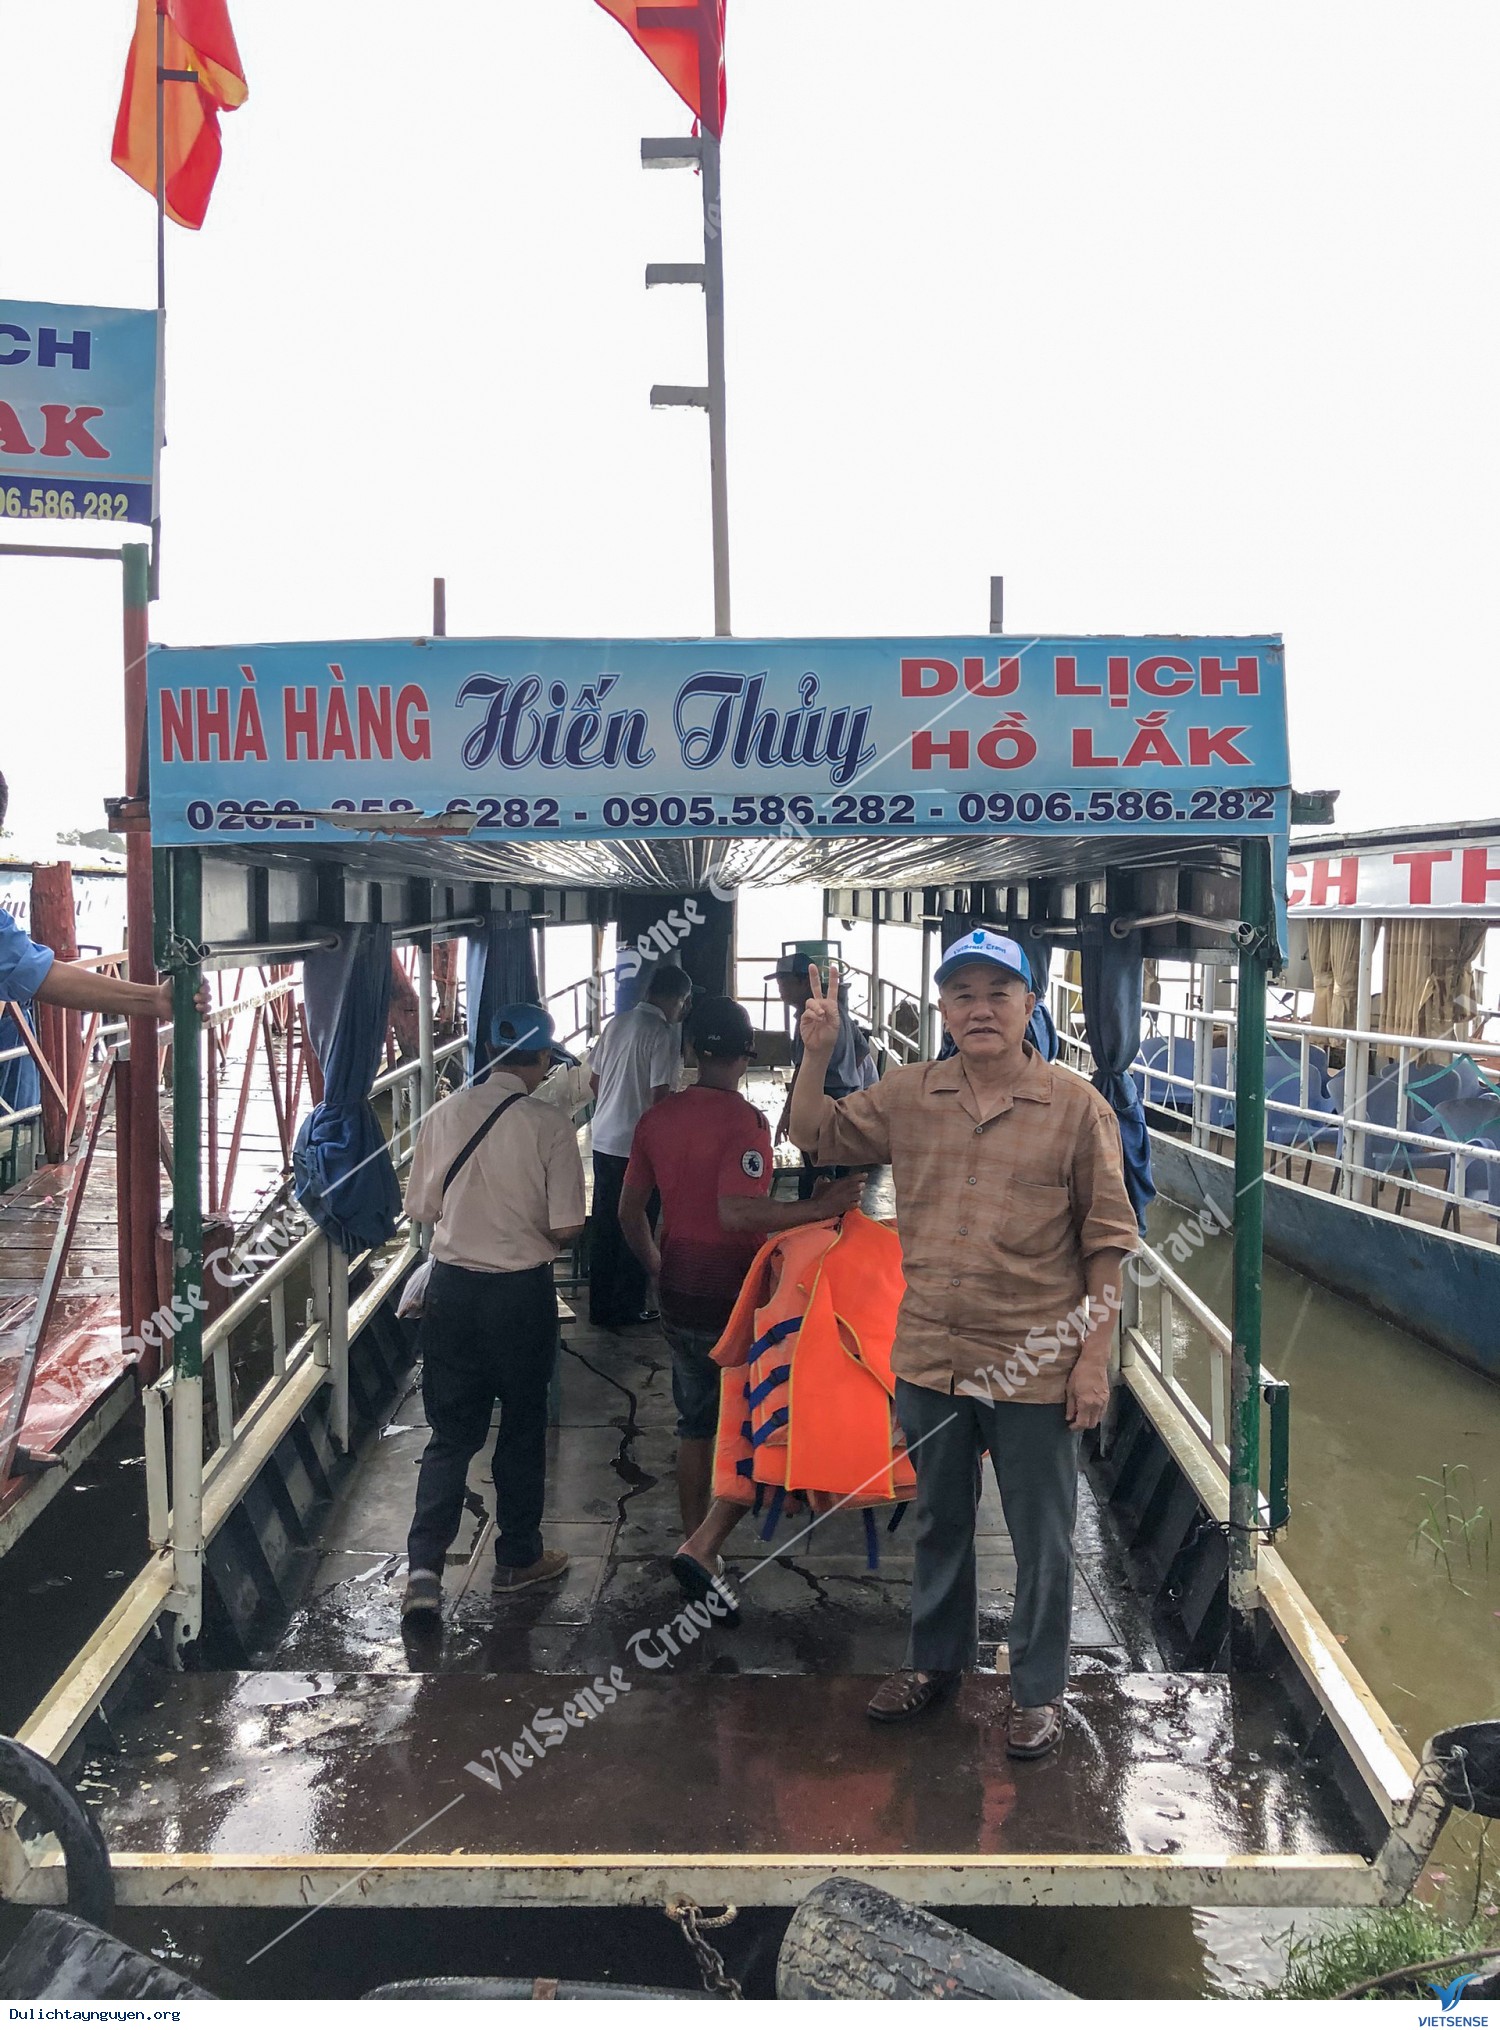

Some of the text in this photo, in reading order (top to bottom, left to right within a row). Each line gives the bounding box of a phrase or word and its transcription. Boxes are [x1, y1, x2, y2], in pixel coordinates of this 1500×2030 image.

[900, 656, 1261, 708] DU LỊCH
[160, 664, 877, 787] NHÀ HÀNG Hiến Thủy
[911, 709, 1257, 770] HỒ LẮK
[603, 794, 916, 827] 0905.586.282
[958, 789, 1276, 824] 0906.586.282
